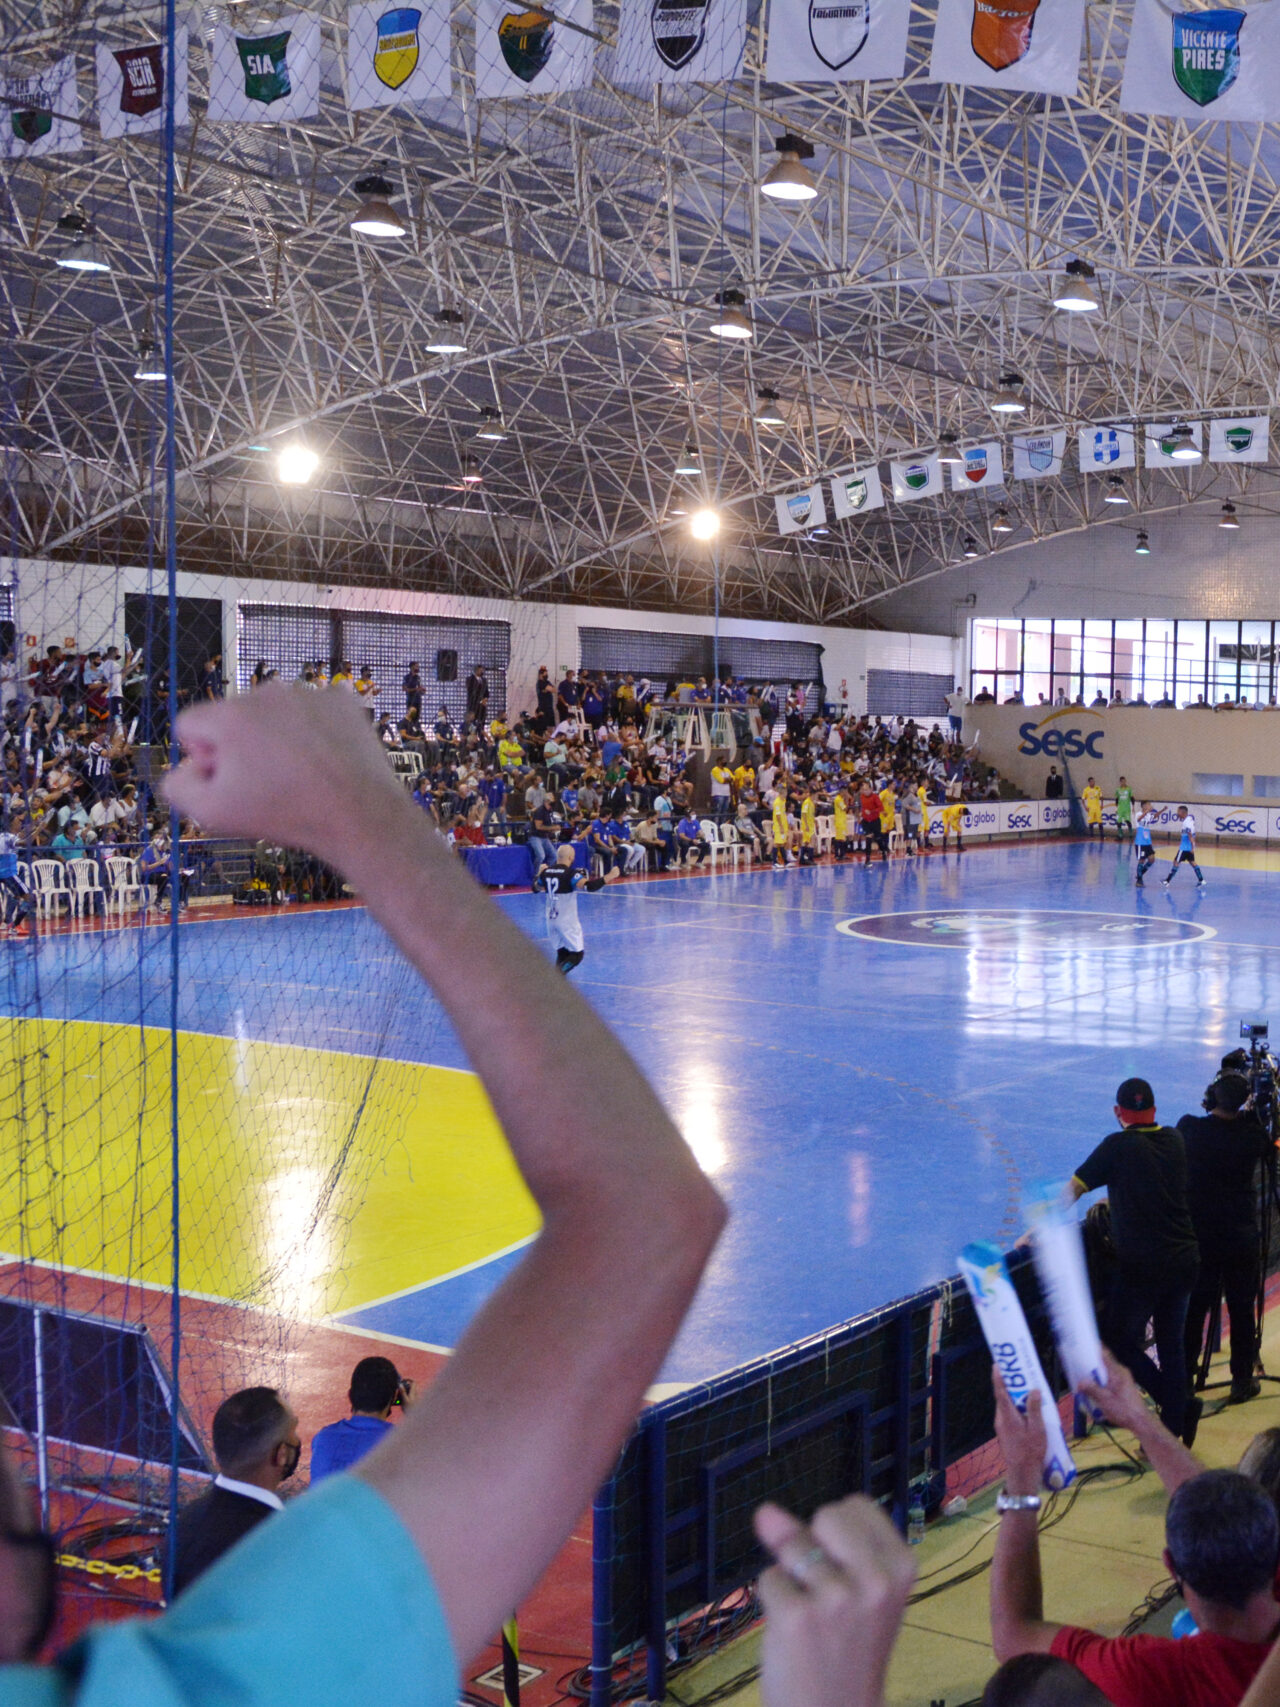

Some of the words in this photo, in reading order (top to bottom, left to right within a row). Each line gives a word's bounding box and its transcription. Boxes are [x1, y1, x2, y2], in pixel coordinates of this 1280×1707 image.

[1181, 28, 1227, 48] VICENTE
[247, 54, 276, 75] SIA
[1182, 49, 1226, 71] PIRES
[1019, 722, 1105, 760] Sesc
[973, 811, 996, 826] globo
[1007, 812, 1032, 828] Sesc
[1215, 817, 1256, 834] Sesc
[545, 877, 559, 900] 12
